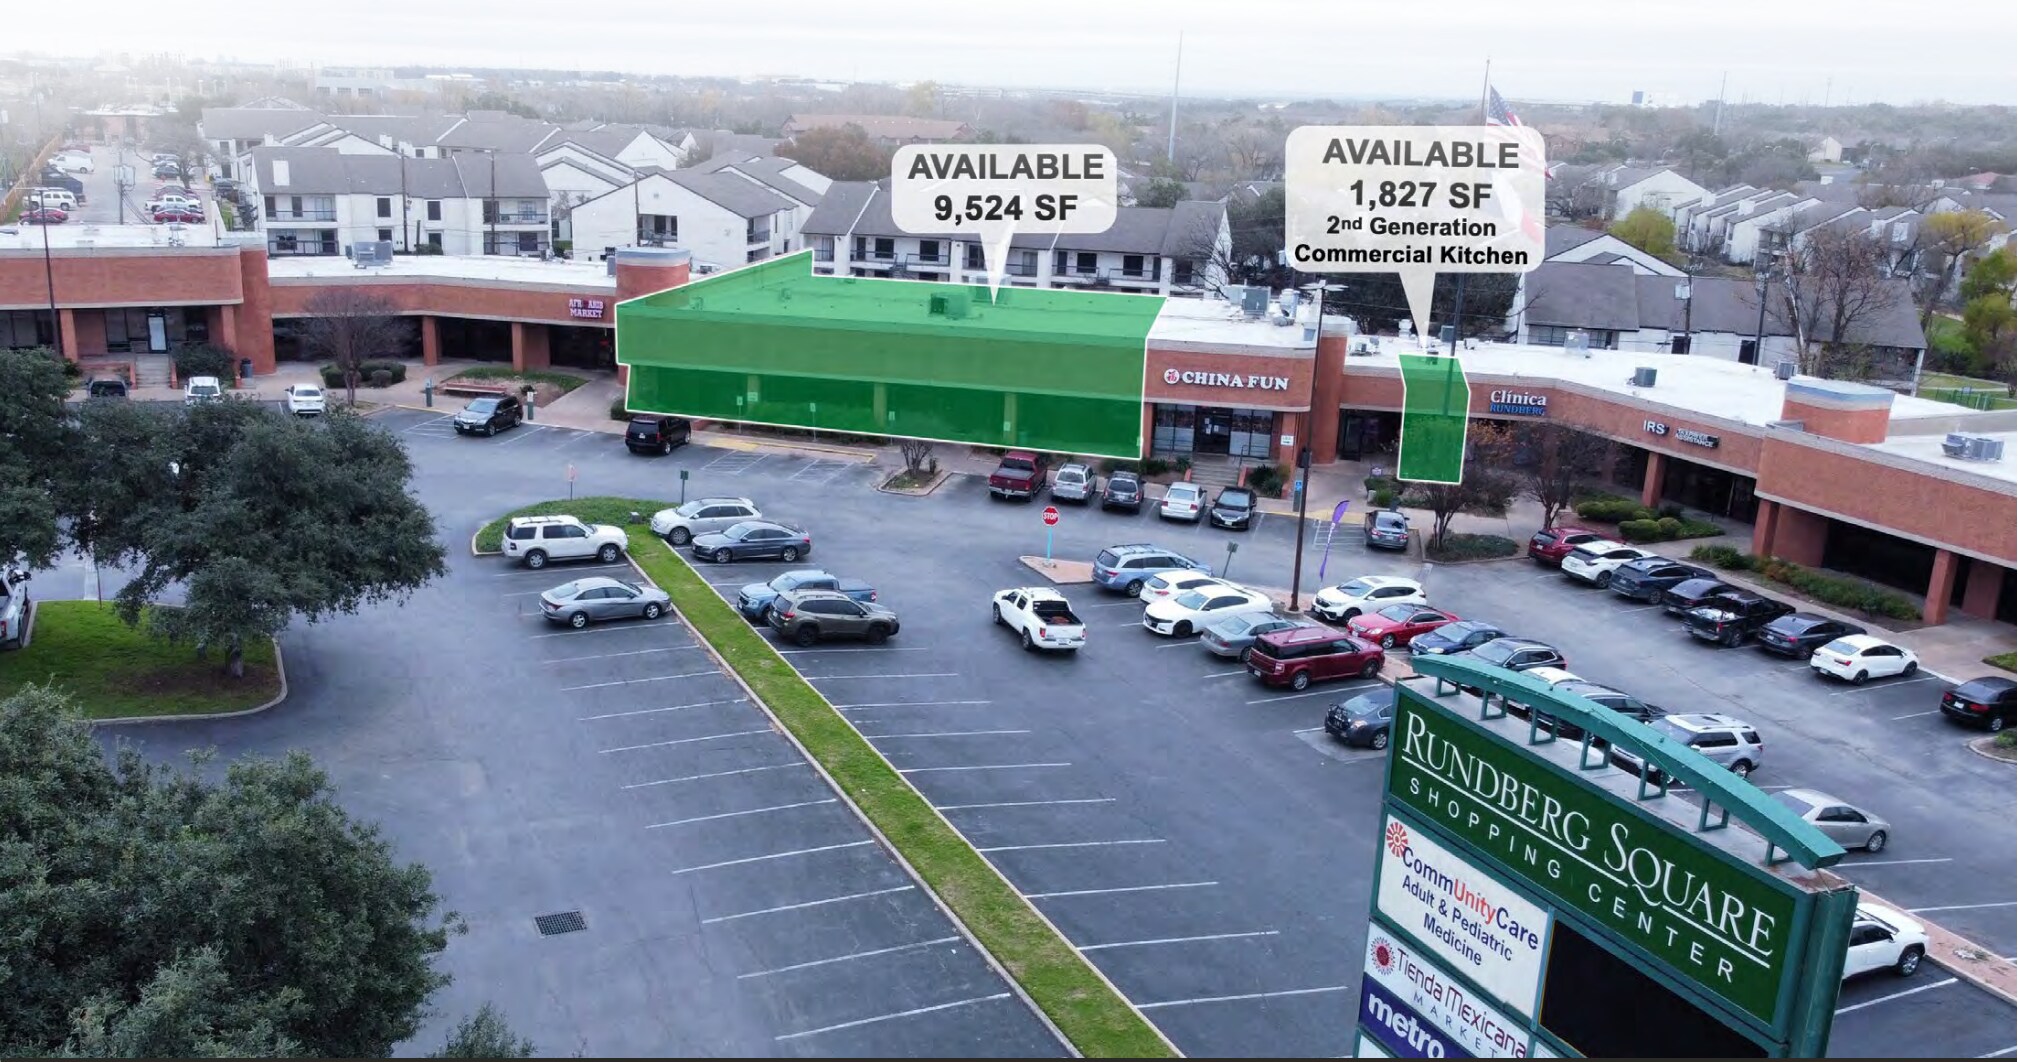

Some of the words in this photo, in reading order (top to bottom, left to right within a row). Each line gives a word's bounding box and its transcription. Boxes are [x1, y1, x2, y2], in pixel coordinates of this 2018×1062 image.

[570, 308, 602, 318] MARKET
[1182, 371, 1244, 388] CHINA
[1247, 375, 1289, 391] FUN
[1490, 389, 1547, 406] Clínica
[1490, 402, 1545, 416] RUNDBERG
[1643, 420, 1665, 435] IRS
[1043, 512, 1058, 520] STOP
[1402, 711, 1591, 851] RUNDBERG
[1604, 823, 1775, 957] SQUARE
[1402, 847, 1539, 950] CommUnityCare
[1410, 777, 1561, 879] SHOPPING
[1588, 883, 1734, 983] CENTER
[1402, 875, 1435, 909] Adult
[1438, 899, 1448, 917] &
[1452, 907, 1513, 962] Pediatric
[1424, 912, 1483, 966] Medicine
[1368, 993, 1445, 1058] metro
[1397, 948, 1443, 1002] Tienda
[1445, 985, 1528, 1058] Mexicana
[1413, 991, 1498, 1058] MARKET
